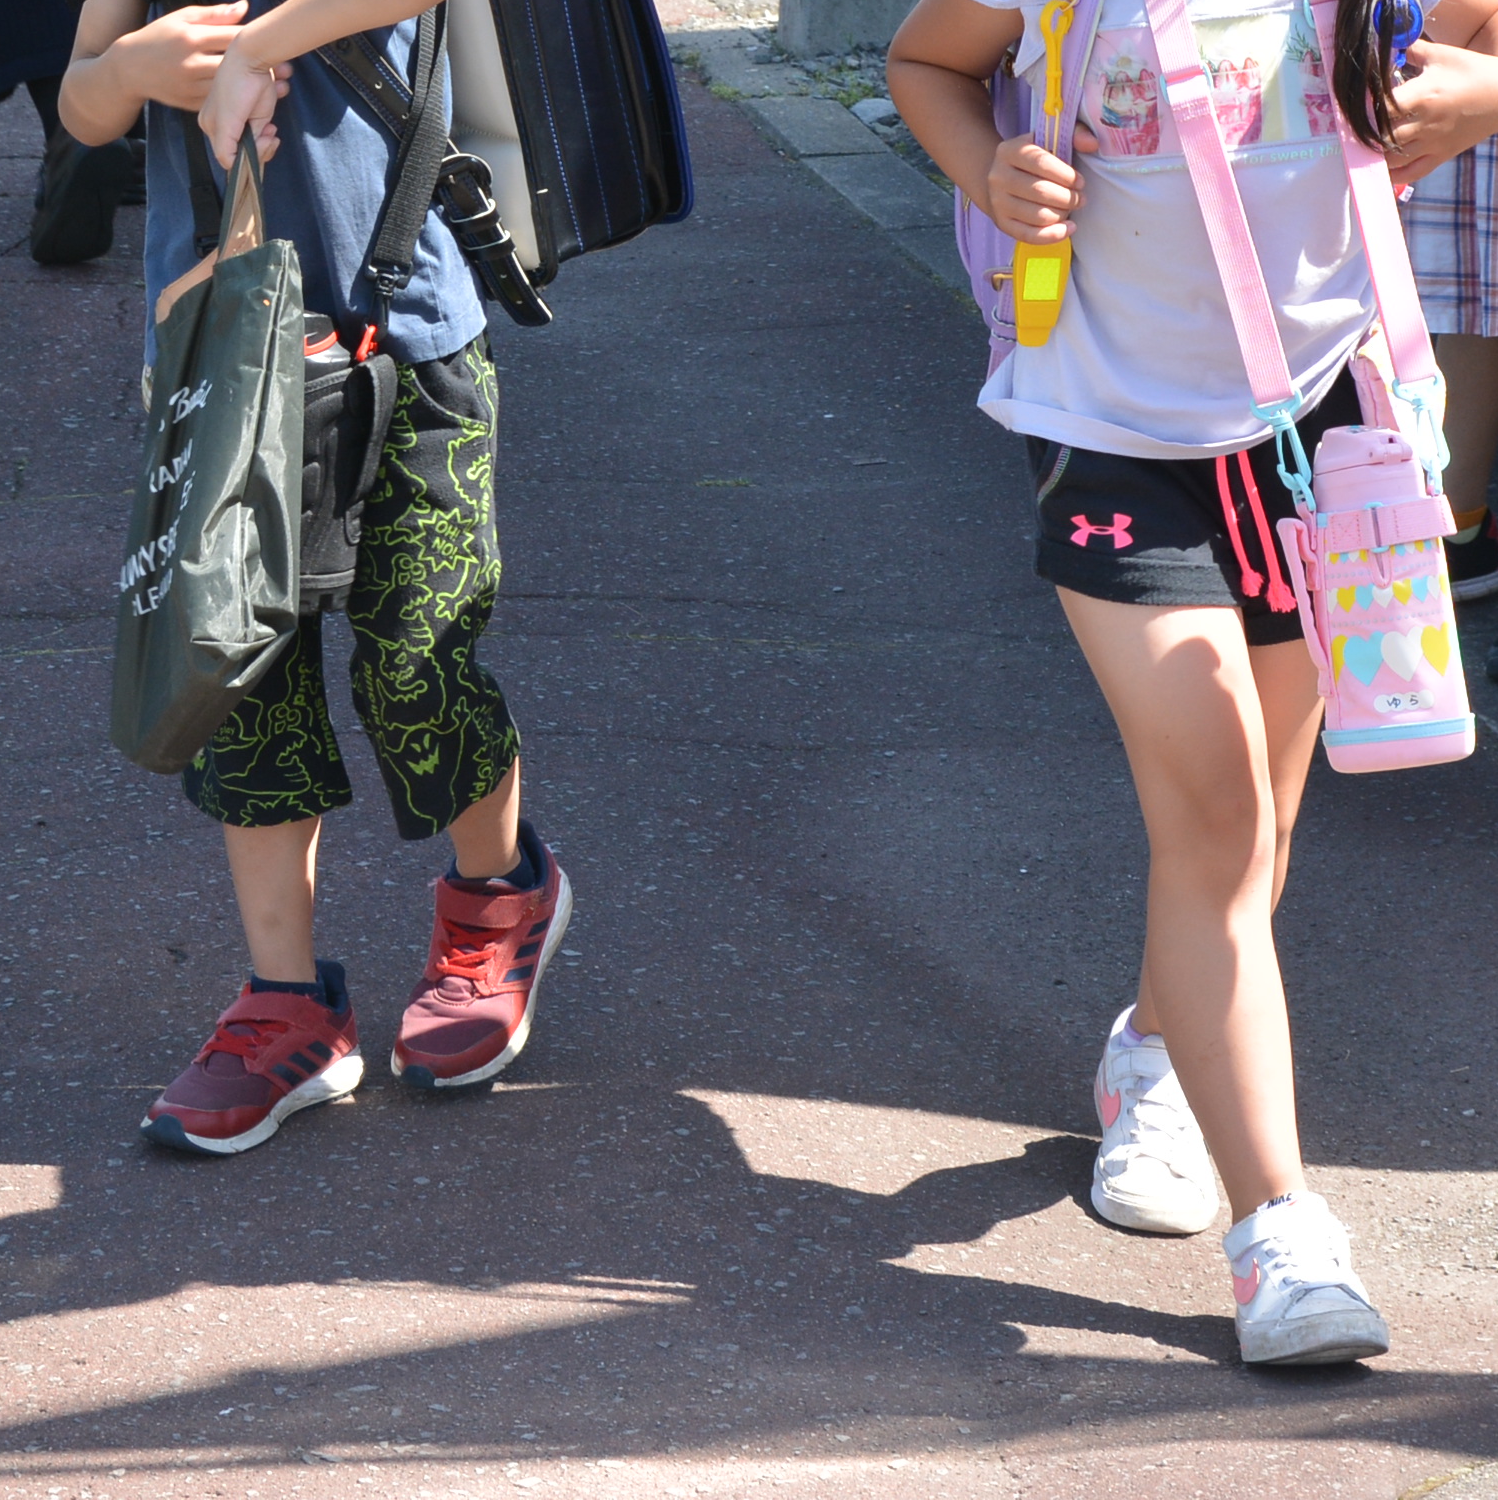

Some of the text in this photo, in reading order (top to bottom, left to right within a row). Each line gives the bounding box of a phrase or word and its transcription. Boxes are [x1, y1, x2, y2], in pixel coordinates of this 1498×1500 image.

[1270, 149, 1314, 163] sweet
[435, 519, 460, 541] OH!
[432, 537, 458, 559] NO!
[1386, 694, 1419, 709] ゆら
